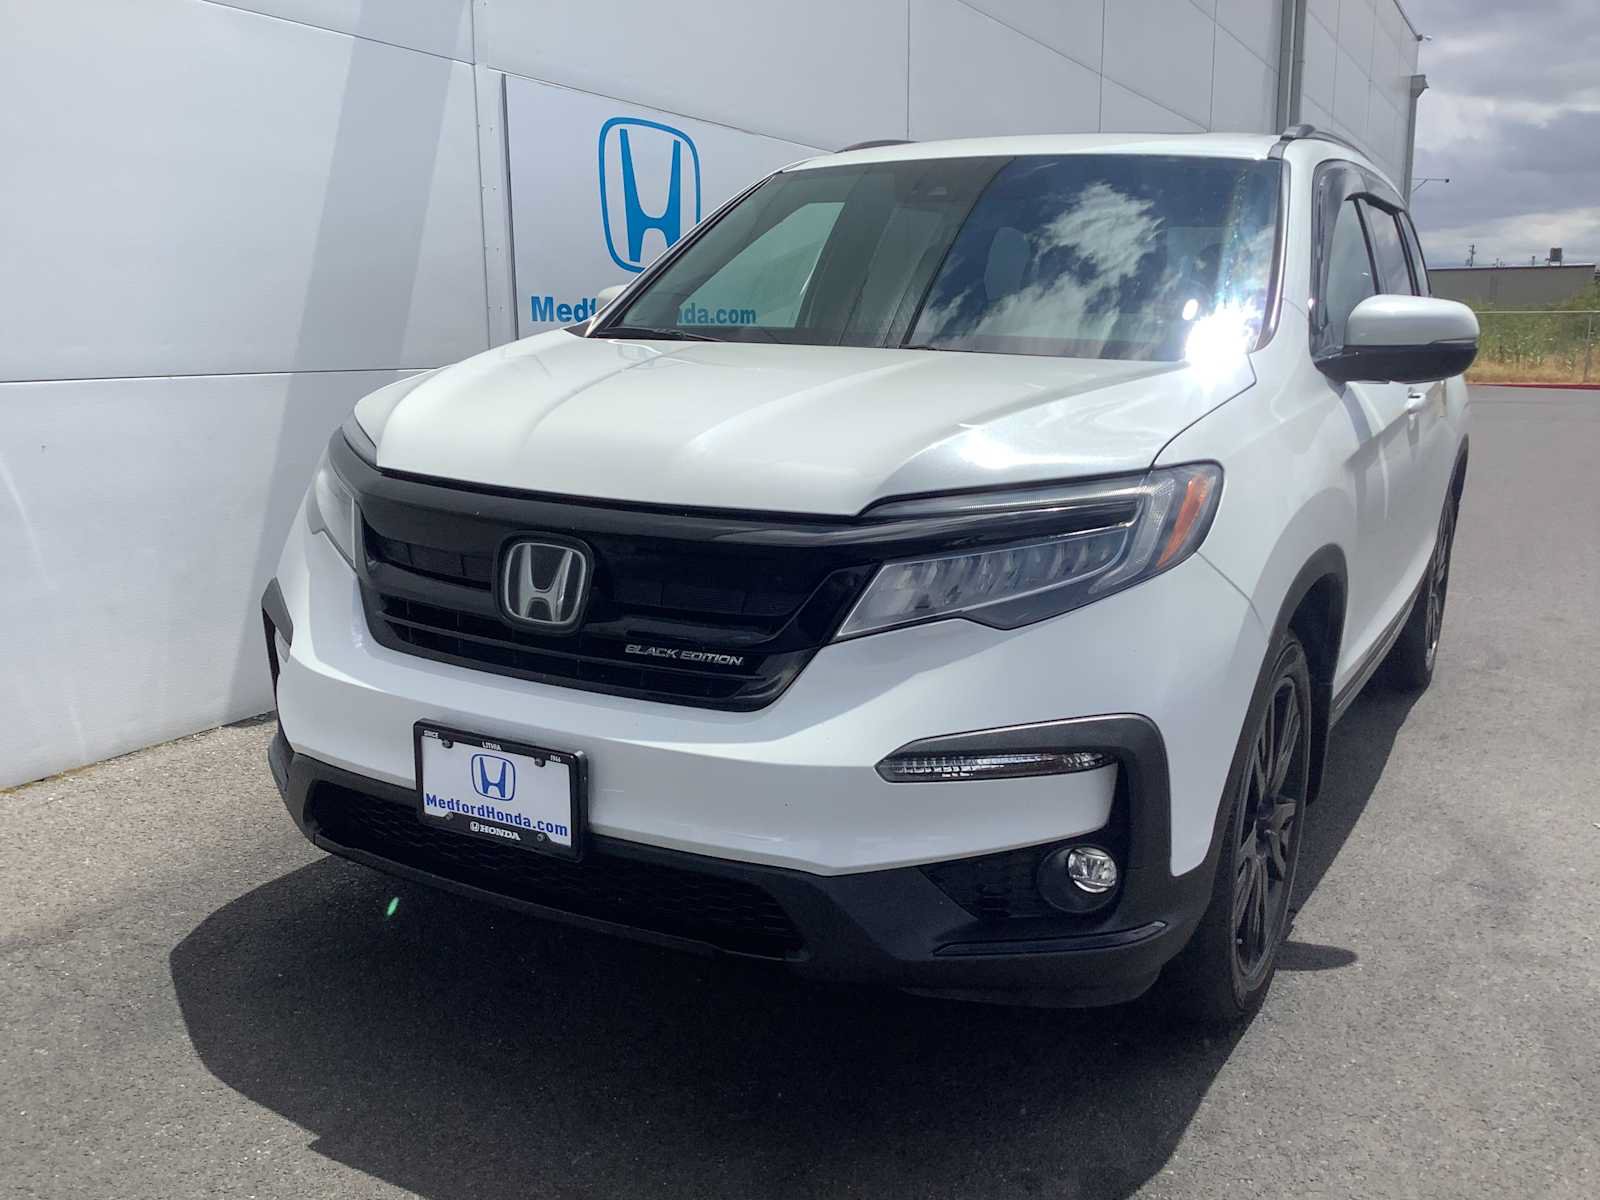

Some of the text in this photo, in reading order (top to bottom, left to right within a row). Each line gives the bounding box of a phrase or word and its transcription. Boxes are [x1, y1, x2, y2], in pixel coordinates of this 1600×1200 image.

[625, 644, 744, 666] BLACK EDITION
[426, 793, 567, 836] MedfordHonda.com
[480, 824, 521, 841] HONDA
